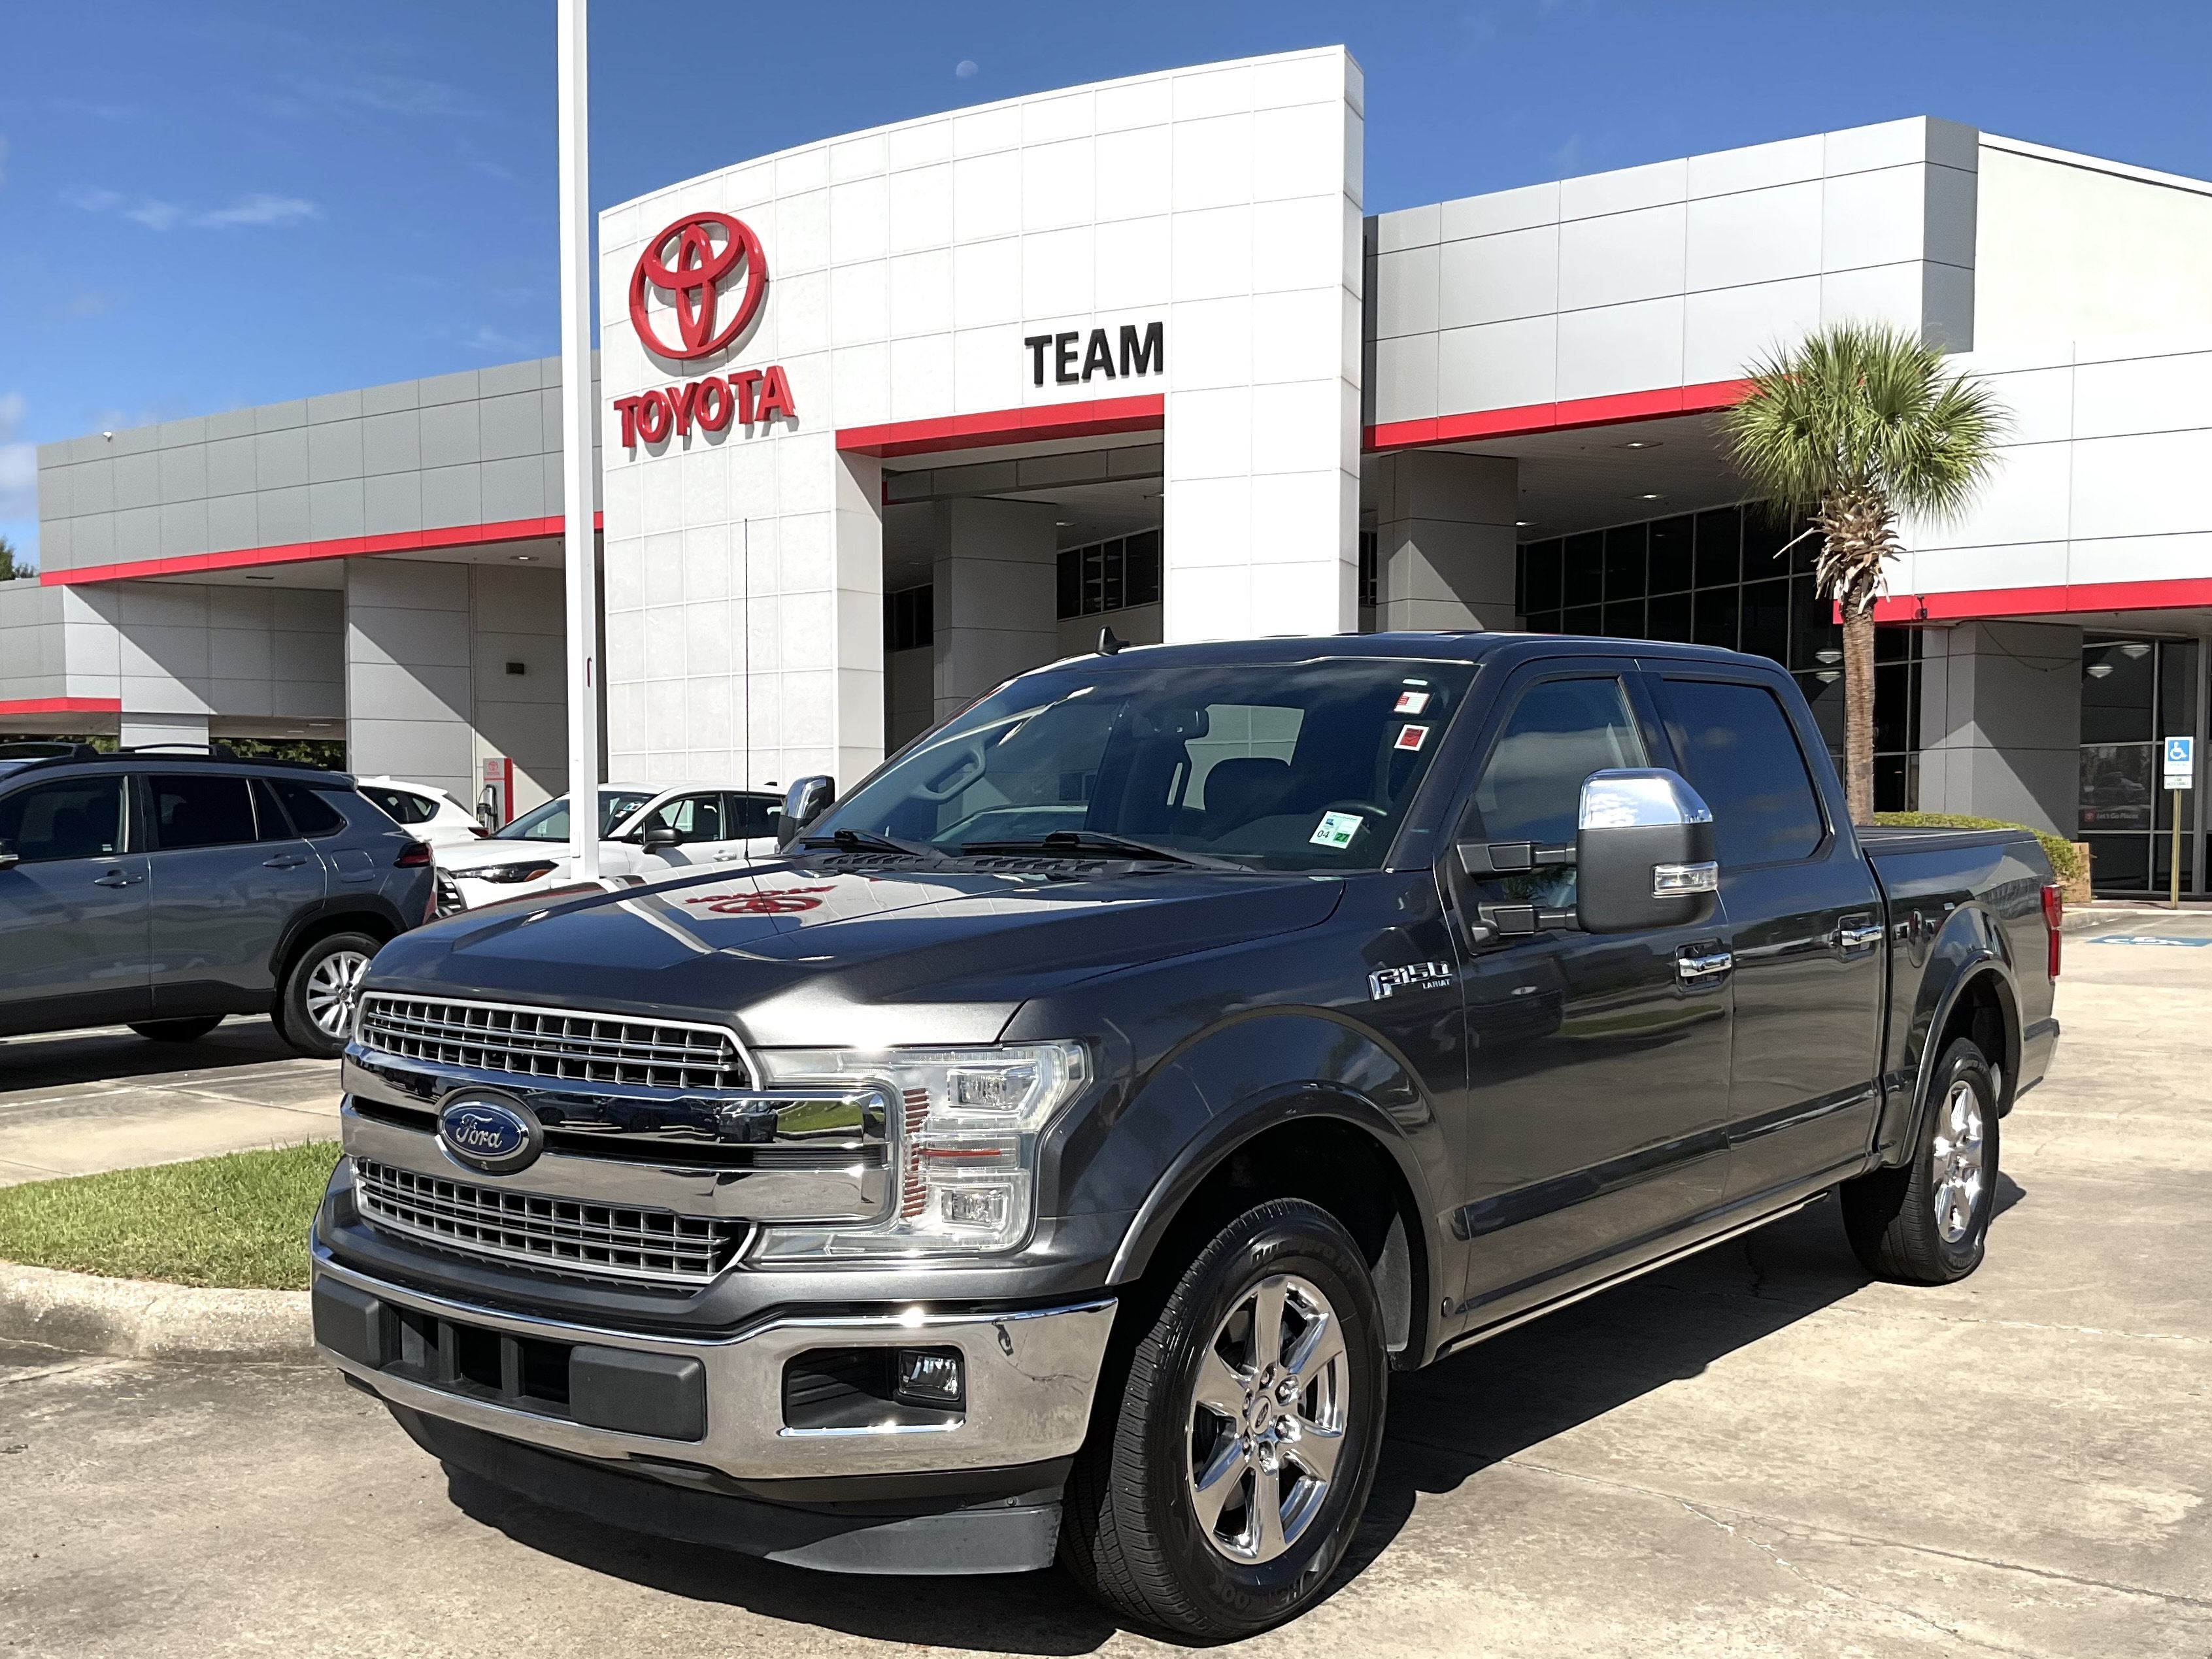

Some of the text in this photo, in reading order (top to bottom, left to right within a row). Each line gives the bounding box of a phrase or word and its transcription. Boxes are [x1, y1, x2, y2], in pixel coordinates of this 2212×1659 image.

[1024, 322, 1164, 386] TEAM
[614, 365, 797, 448] TOYOTA
[1317, 830, 1330, 839] 04
[1335, 833, 1350, 842] 27
[1422, 978, 1451, 990] LARIAT
[456, 1113, 505, 1149] Ford
